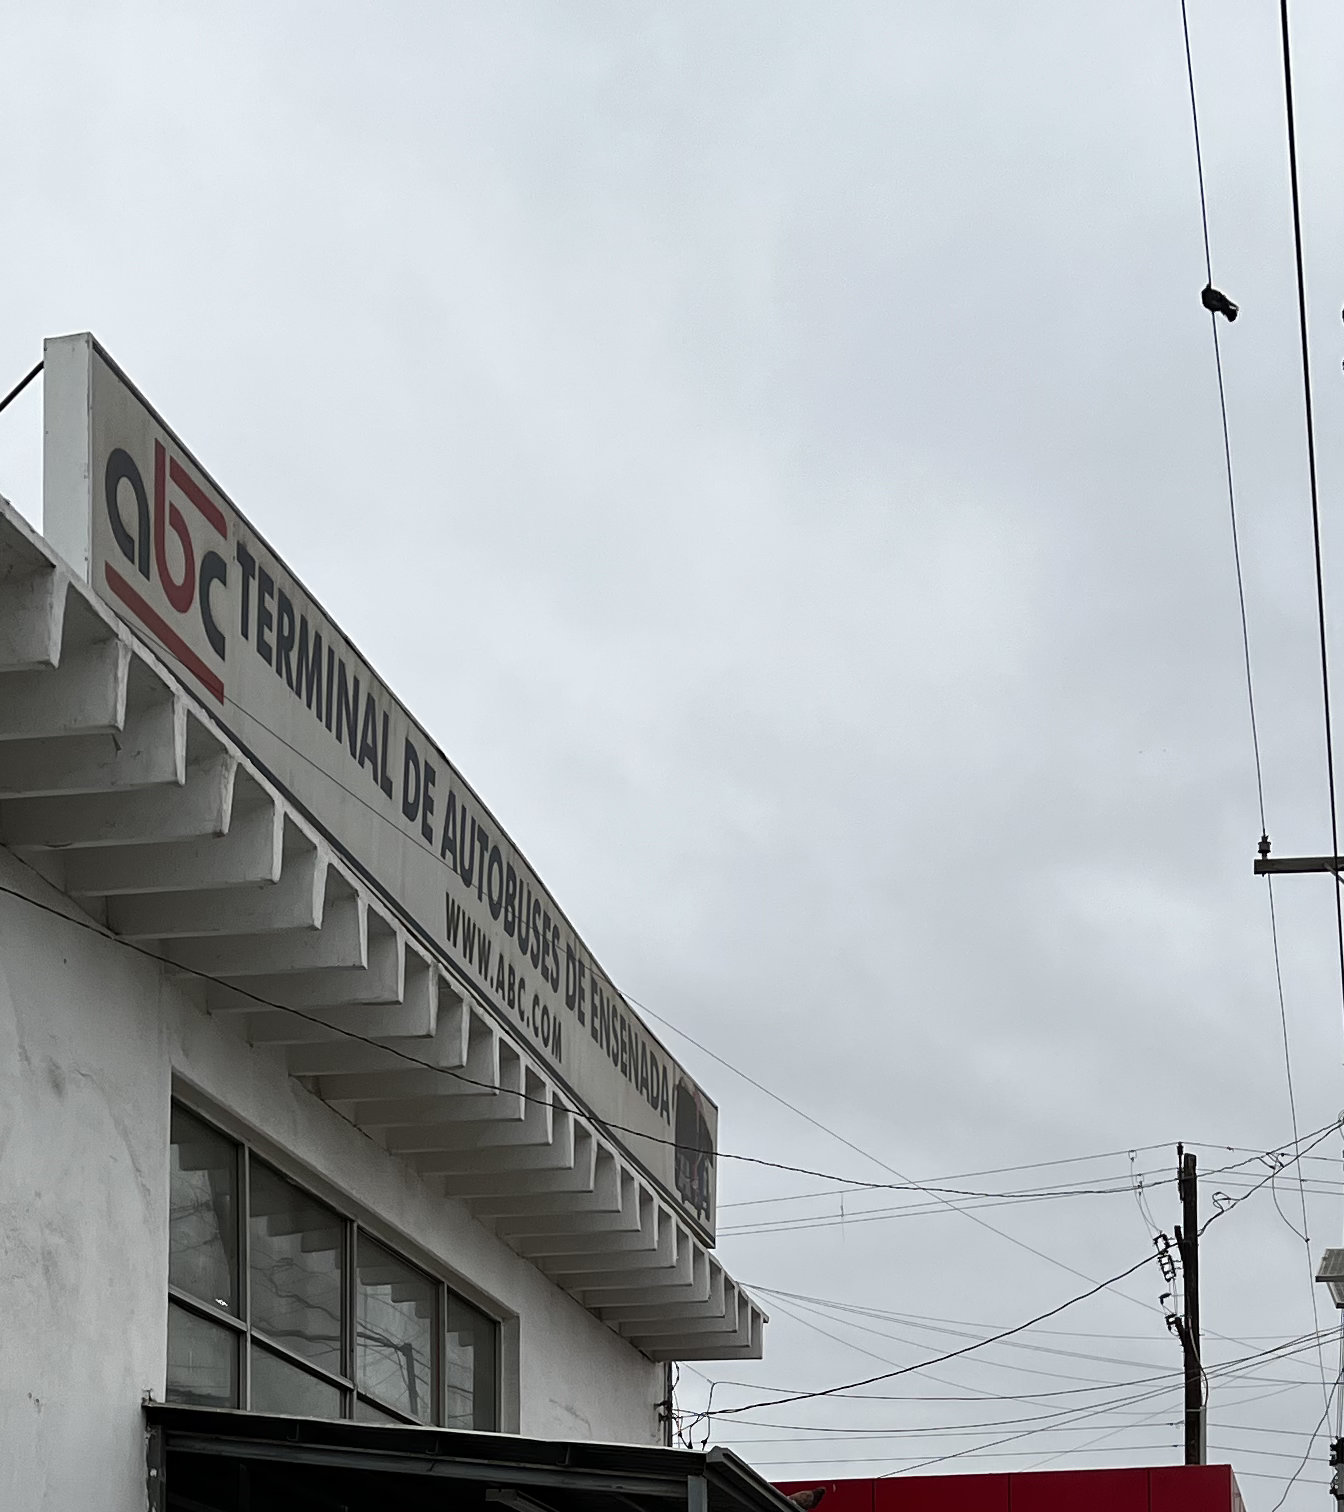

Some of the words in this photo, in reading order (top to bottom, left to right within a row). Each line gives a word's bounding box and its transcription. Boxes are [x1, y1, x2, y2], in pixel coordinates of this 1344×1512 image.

[105, 438, 227, 662] abc
[236, 539, 393, 800] TERMINAL
[401, 736, 437, 846] DE
[440, 788, 561, 994] AUTOBUSES
[564, 940, 586, 1028] DE
[590, 972, 671, 1127] ENSENADA
[445, 890, 562, 1065] WWW.ABC.COM
